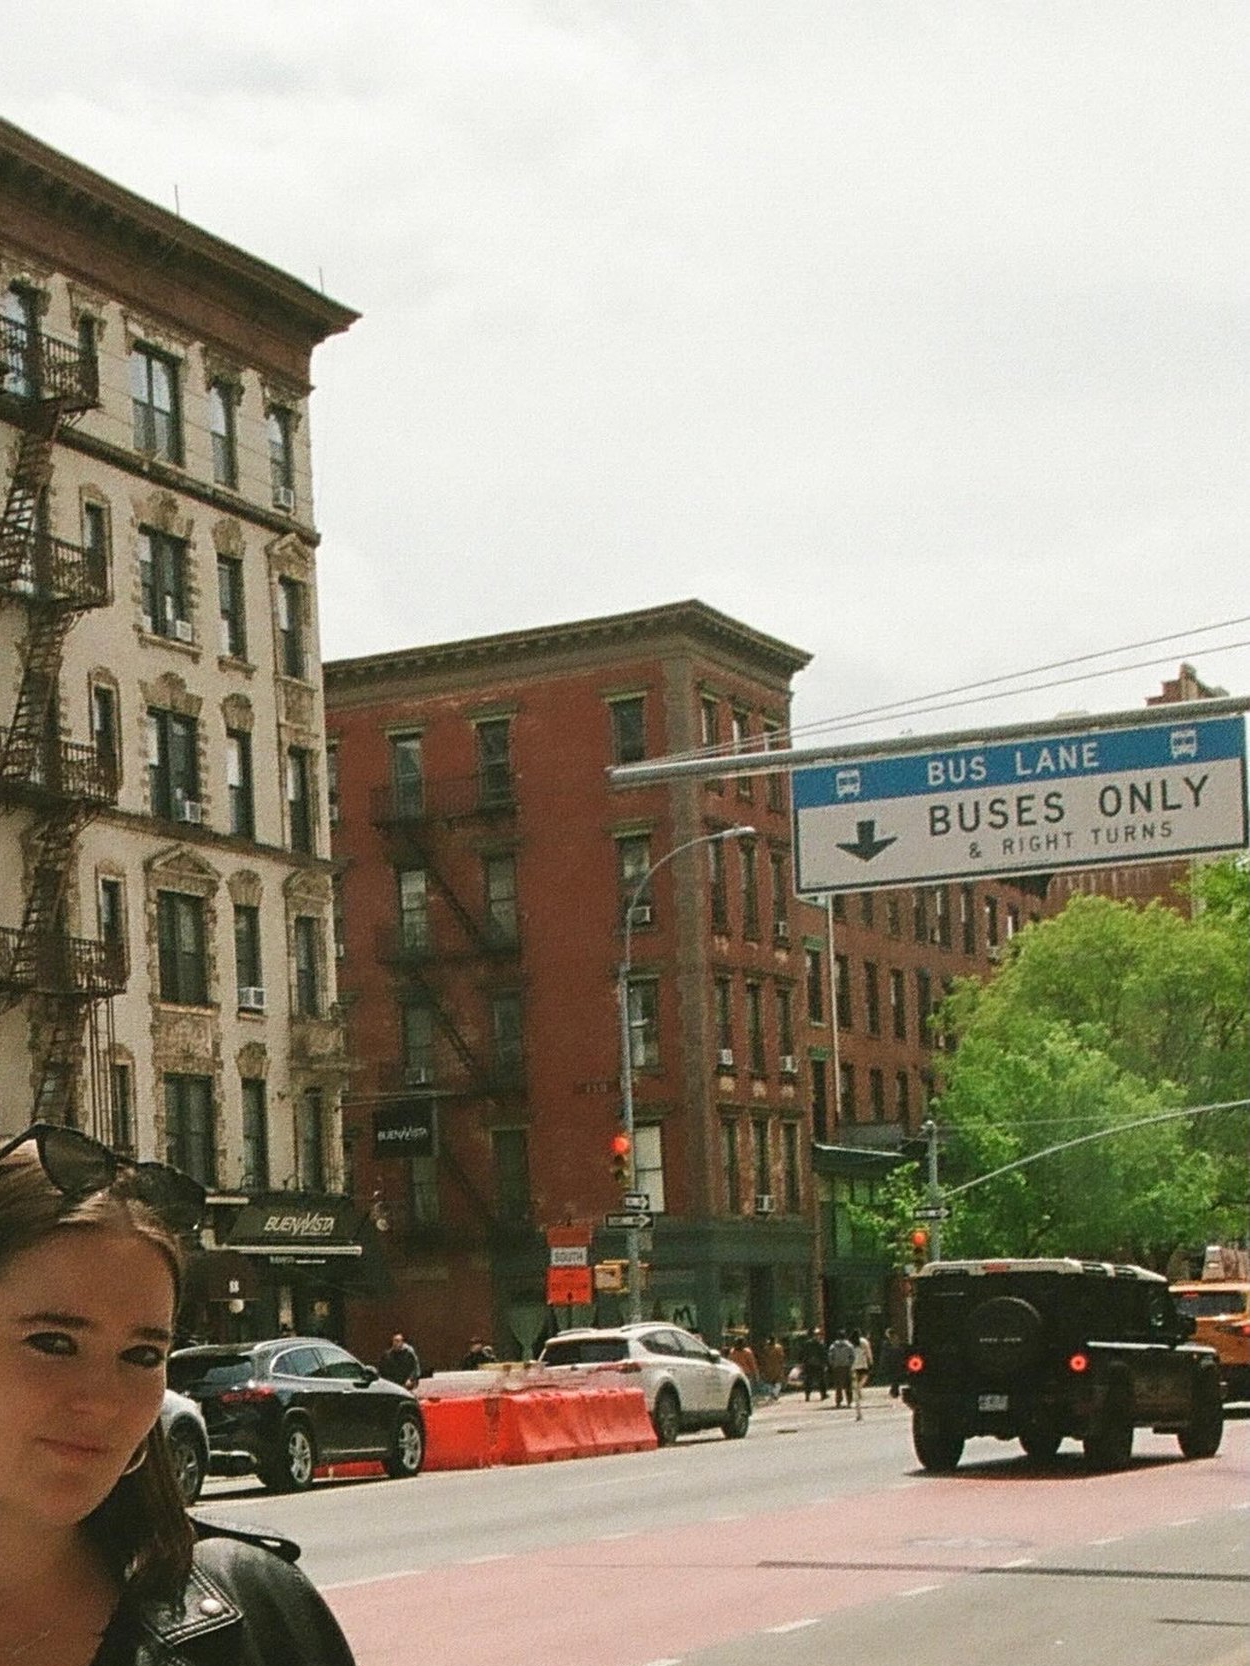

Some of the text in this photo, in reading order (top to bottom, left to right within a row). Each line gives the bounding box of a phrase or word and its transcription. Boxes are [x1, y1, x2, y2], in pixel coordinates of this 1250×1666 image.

[927, 741, 1100, 787] BUS LANE
[928, 773, 1209, 837] BUSES ONLY
[968, 820, 1173, 859] & RIGHT TURNS
